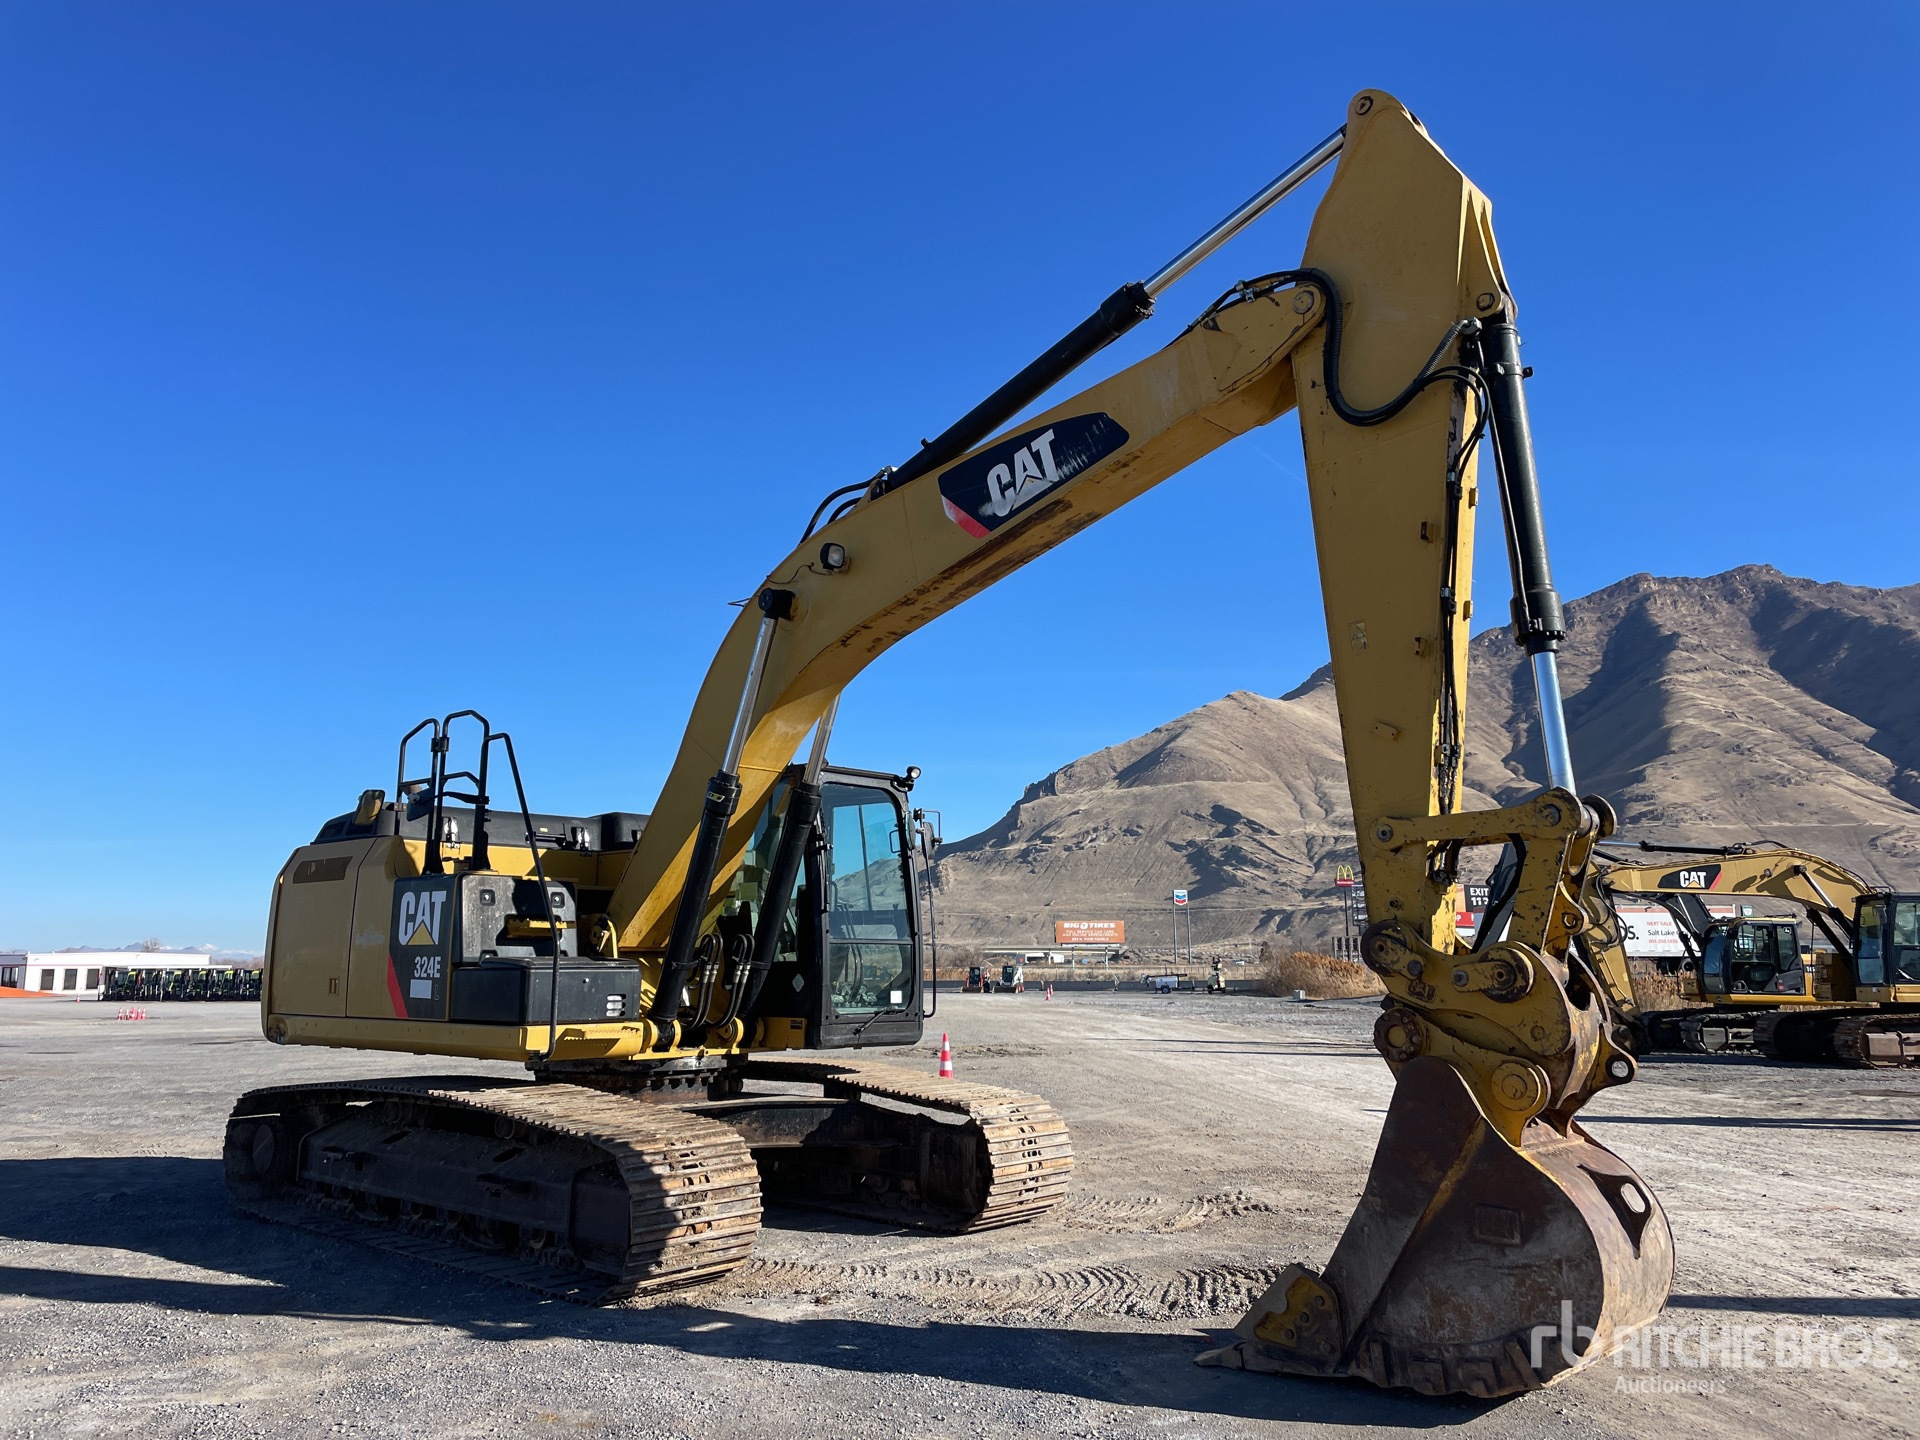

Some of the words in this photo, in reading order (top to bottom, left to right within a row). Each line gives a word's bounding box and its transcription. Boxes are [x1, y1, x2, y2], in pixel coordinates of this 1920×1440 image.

[987, 428, 1060, 517] CAT
[1679, 870, 1707, 888] CAT
[1469, 887, 1490, 896] EXIT
[398, 890, 447, 946] CAT
[413, 955, 441, 978] 324E
